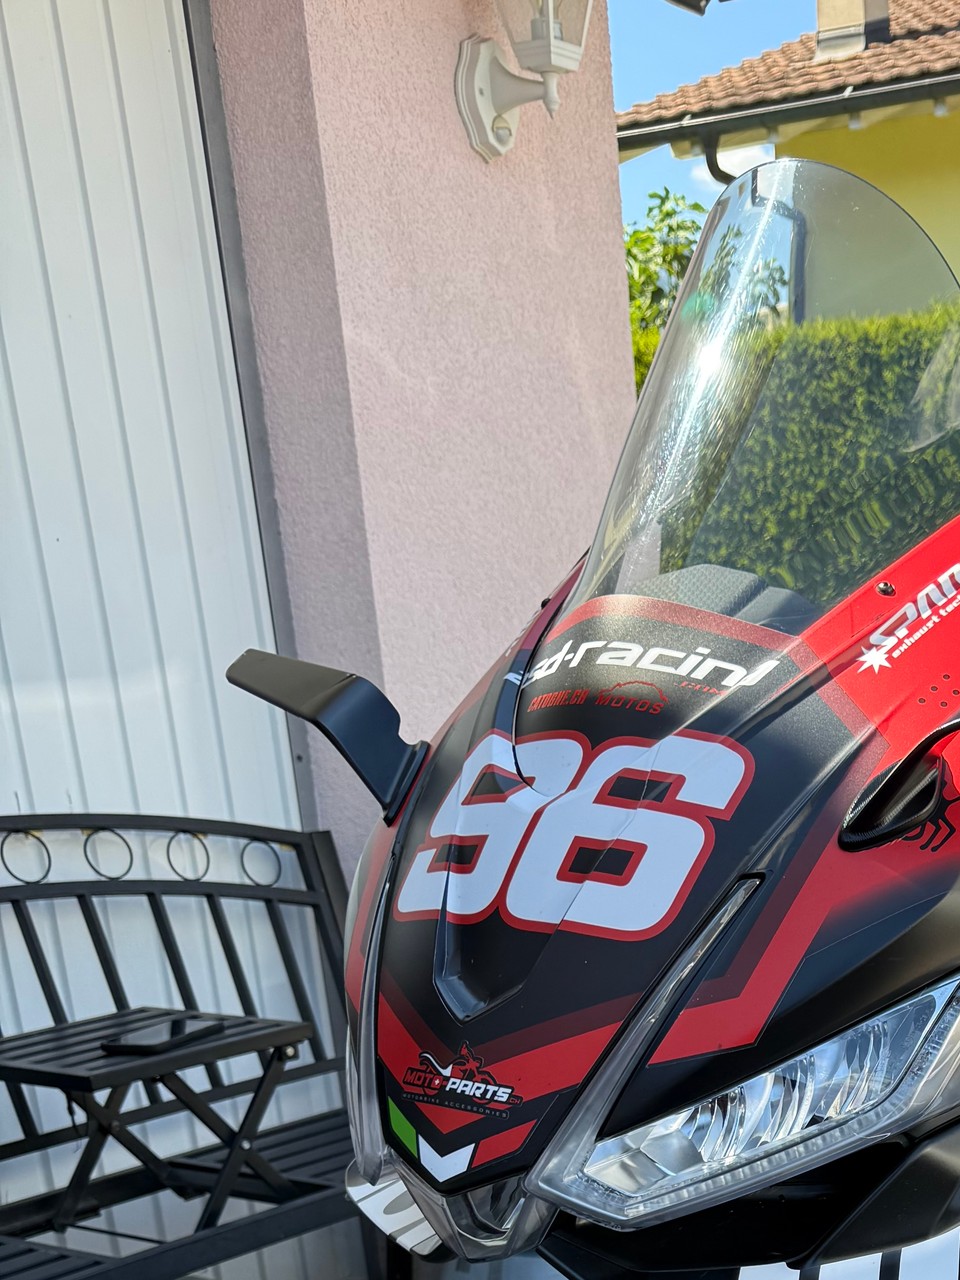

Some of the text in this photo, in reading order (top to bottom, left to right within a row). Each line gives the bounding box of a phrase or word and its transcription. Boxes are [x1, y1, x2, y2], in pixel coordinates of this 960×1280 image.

[891, 609, 941, 659] exhaust
[594, 692, 666, 716] MOTOS
[396, 728, 754, 941] 96
